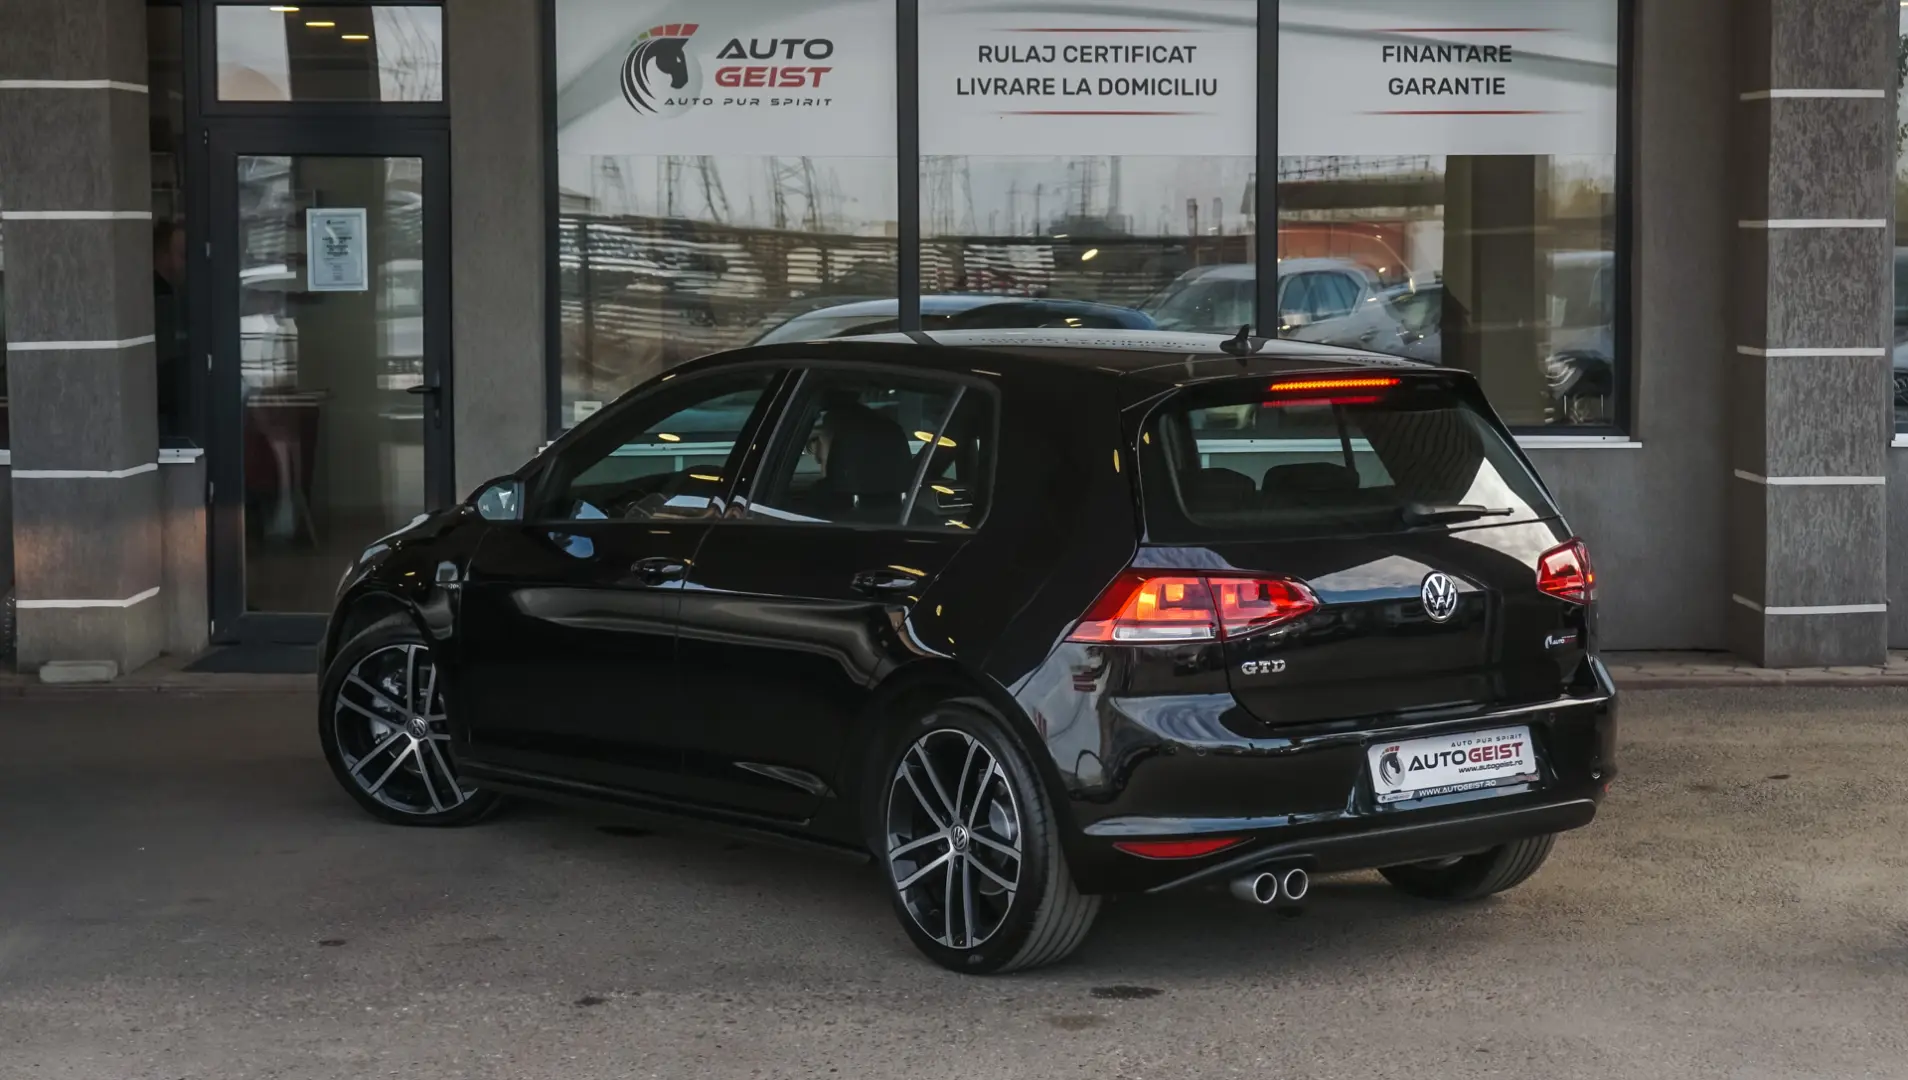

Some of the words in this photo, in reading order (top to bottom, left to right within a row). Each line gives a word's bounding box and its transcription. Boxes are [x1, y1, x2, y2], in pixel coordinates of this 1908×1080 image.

[716, 38, 834, 60] AUTO
[978, 45, 1056, 63] RULAJ
[1063, 45, 1197, 63] CERTIFICAT
[1382, 45, 1512, 63] FINANTARE
[715, 66, 833, 88] GEIST
[956, 78, 1056, 96] LIVRARE
[1062, 78, 1092, 96] LA
[1098, 78, 1217, 96] DOMICILIU
[1388, 77, 1505, 96] GARANTIE
[664, 97, 713, 106] AUTO
[723, 97, 760, 106] PUR
[770, 97, 832, 106] SPIRIT
[1241, 659, 1286, 675] GTD
[1451, 740, 1473, 748] AUTO
[1496, 733, 1522, 741] SPIRIT
[1458, 760, 1523, 773] www.autogeist.ro
[1419, 780, 1496, 796] WWW.AUTOGEIST.RO
